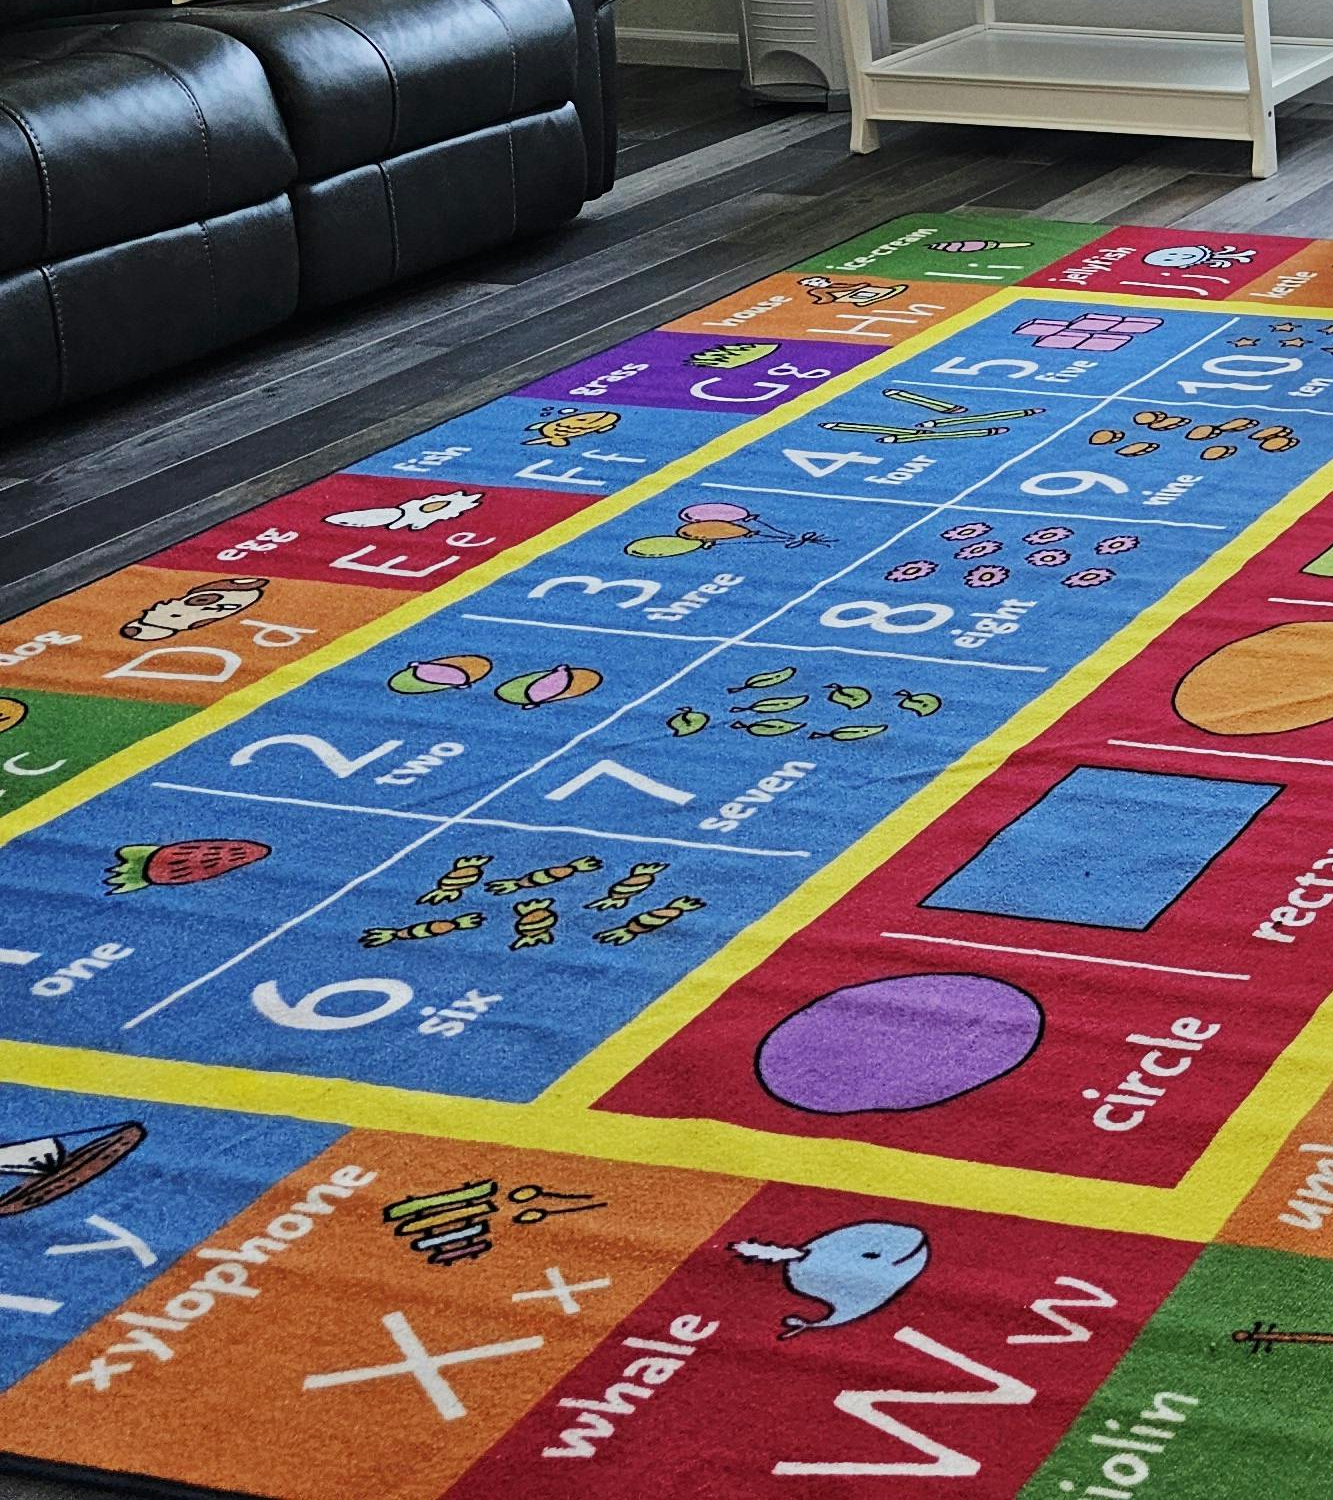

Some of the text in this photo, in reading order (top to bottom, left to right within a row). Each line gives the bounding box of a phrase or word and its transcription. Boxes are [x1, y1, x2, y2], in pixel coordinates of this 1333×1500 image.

[827, 227, 937, 272] ice-cream
[1049, 246, 1136, 286] jellyfish
[1264, 270, 1317, 299] kettle
[702, 295, 792, 326] house
[568, 361, 650, 397] grass
[930, 356, 1039, 381] 5
[1034, 358, 1098, 384] five
[1177, 354, 1302, 395] 10
[1288, 377, 1333, 399] ten
[393, 446, 471, 474] fish
[782, 446, 884, 479] 4
[864, 454, 938, 488] four
[1020, 470, 1129, 497] 9
[1143, 474, 1204, 507] nine
[217, 528, 299, 562] egg
[528, 575, 661, 610] 3
[646, 571, 746, 624] three
[819, 600, 954, 635] 8
[953, 598, 1037, 649] eight
[230, 733, 403, 780] 2
[375, 740, 464, 788] two
[544, 759, 696, 806] 7
[700, 760, 816, 834] seven
[30, 942, 134, 998] one
[251, 978, 413, 1031] 6
[419, 989, 502, 1037] six
[1092, 1012, 1221, 1137] circle
[70, 1161, 379, 1394] xylophone
[541, 1311, 720, 1461] whale
[1059, 1392, 1199, 1500] iolin
